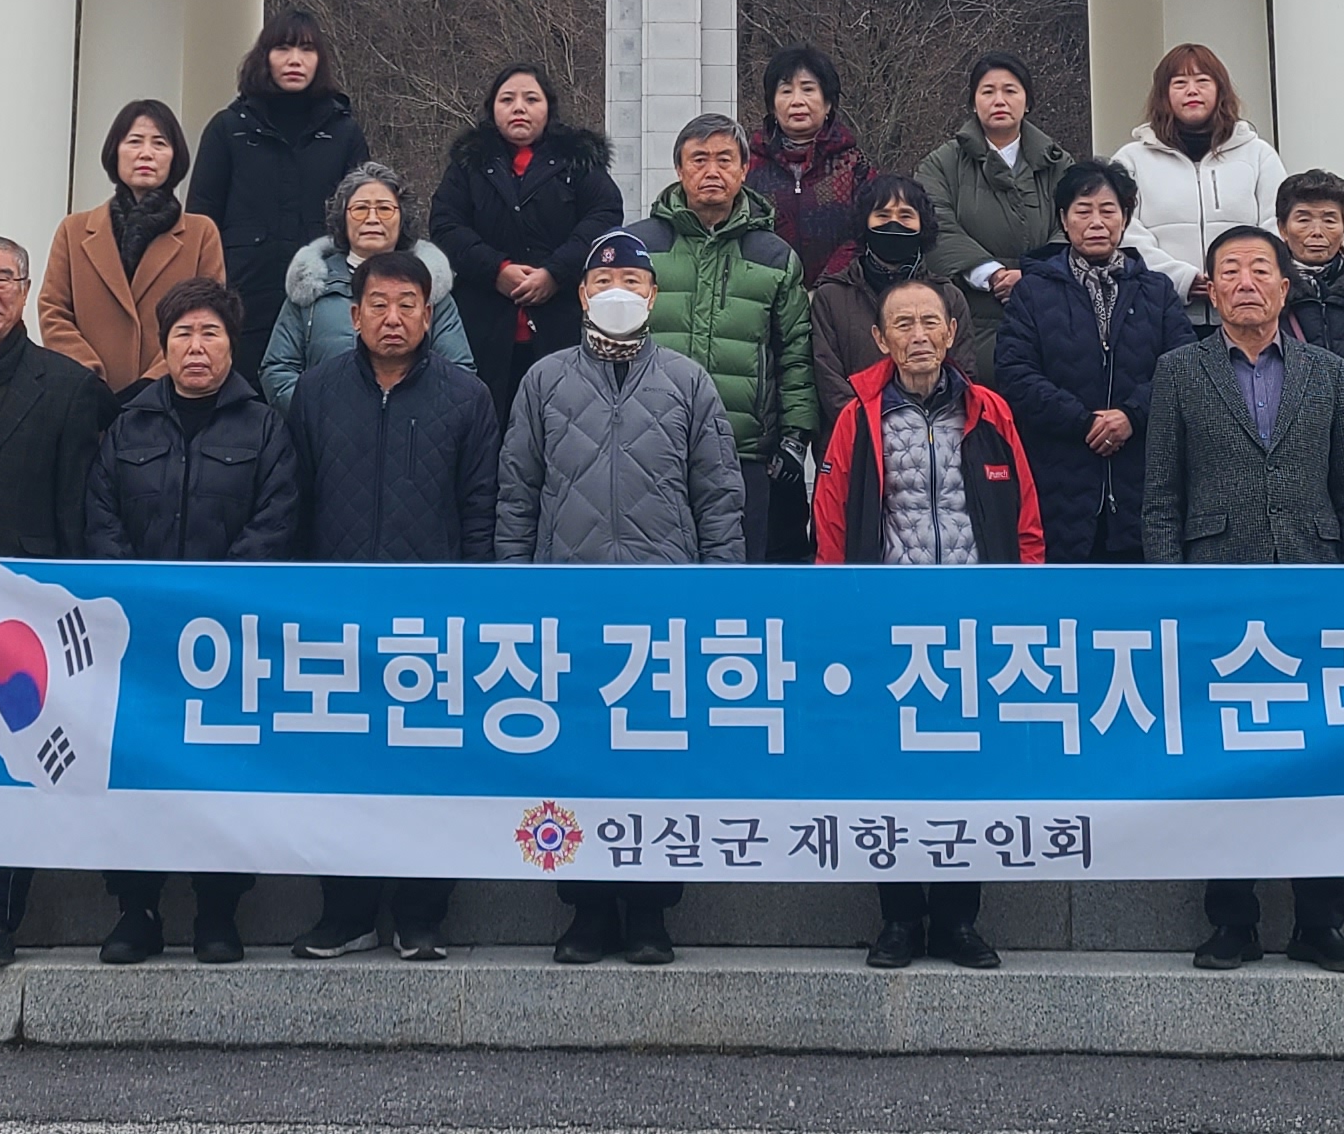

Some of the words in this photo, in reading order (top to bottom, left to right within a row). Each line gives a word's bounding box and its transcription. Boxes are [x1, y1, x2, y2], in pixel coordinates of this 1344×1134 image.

[179, 615, 570, 753] 안보현장
[599, 619, 796, 753] 견학
[887, 619, 1183, 754] 전적지
[598, 814, 768, 867] 임실군
[789, 815, 1091, 870] 재향군인회
